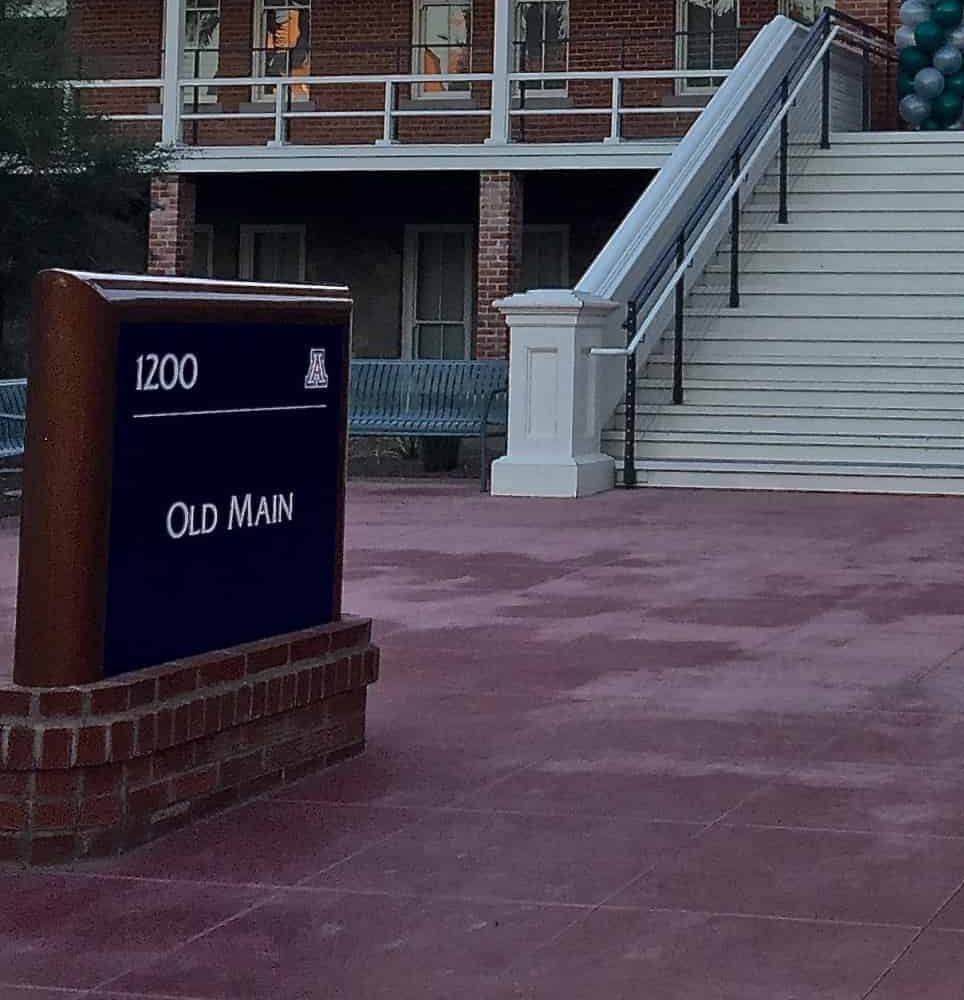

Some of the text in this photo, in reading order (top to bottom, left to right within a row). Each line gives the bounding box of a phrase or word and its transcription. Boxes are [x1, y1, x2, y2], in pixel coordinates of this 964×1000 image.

[135, 353, 199, 391] 1200
[166, 492, 294, 539] OLD MAIN
